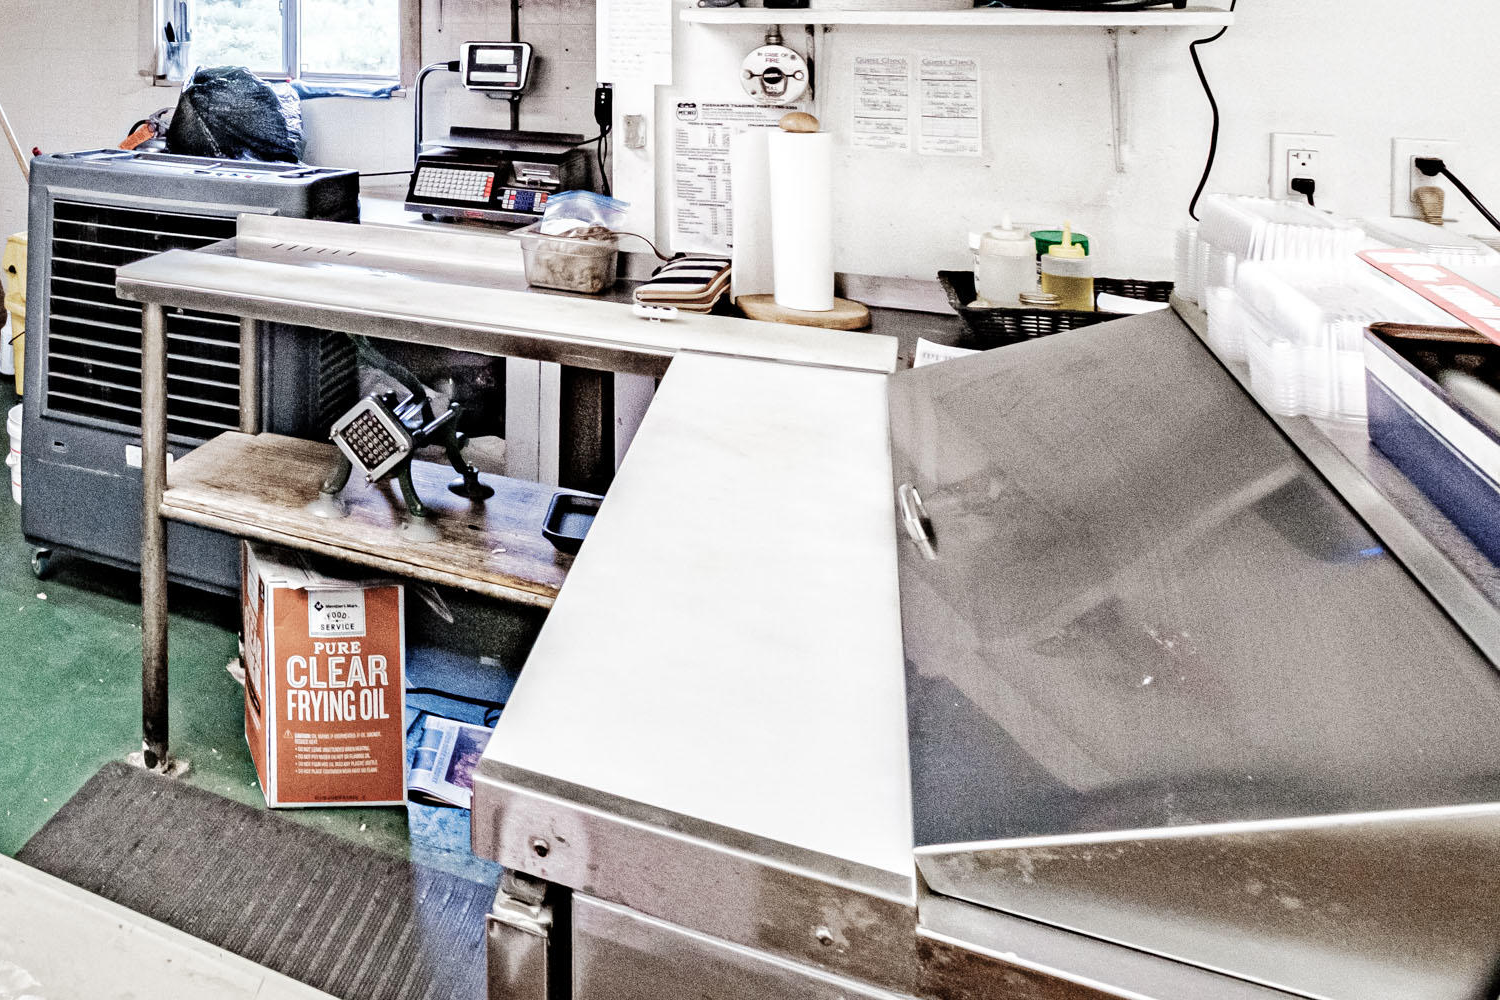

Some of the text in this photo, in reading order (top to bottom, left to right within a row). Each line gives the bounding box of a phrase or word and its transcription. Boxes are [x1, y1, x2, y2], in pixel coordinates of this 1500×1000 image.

[326, 611, 348, 619] FOOD
[320, 622, 355, 631] SERVICE
[313, 641, 362, 655] PURE
[286, 654, 389, 688] CLEAR
[286, 687, 390, 722] FRYING OIL
